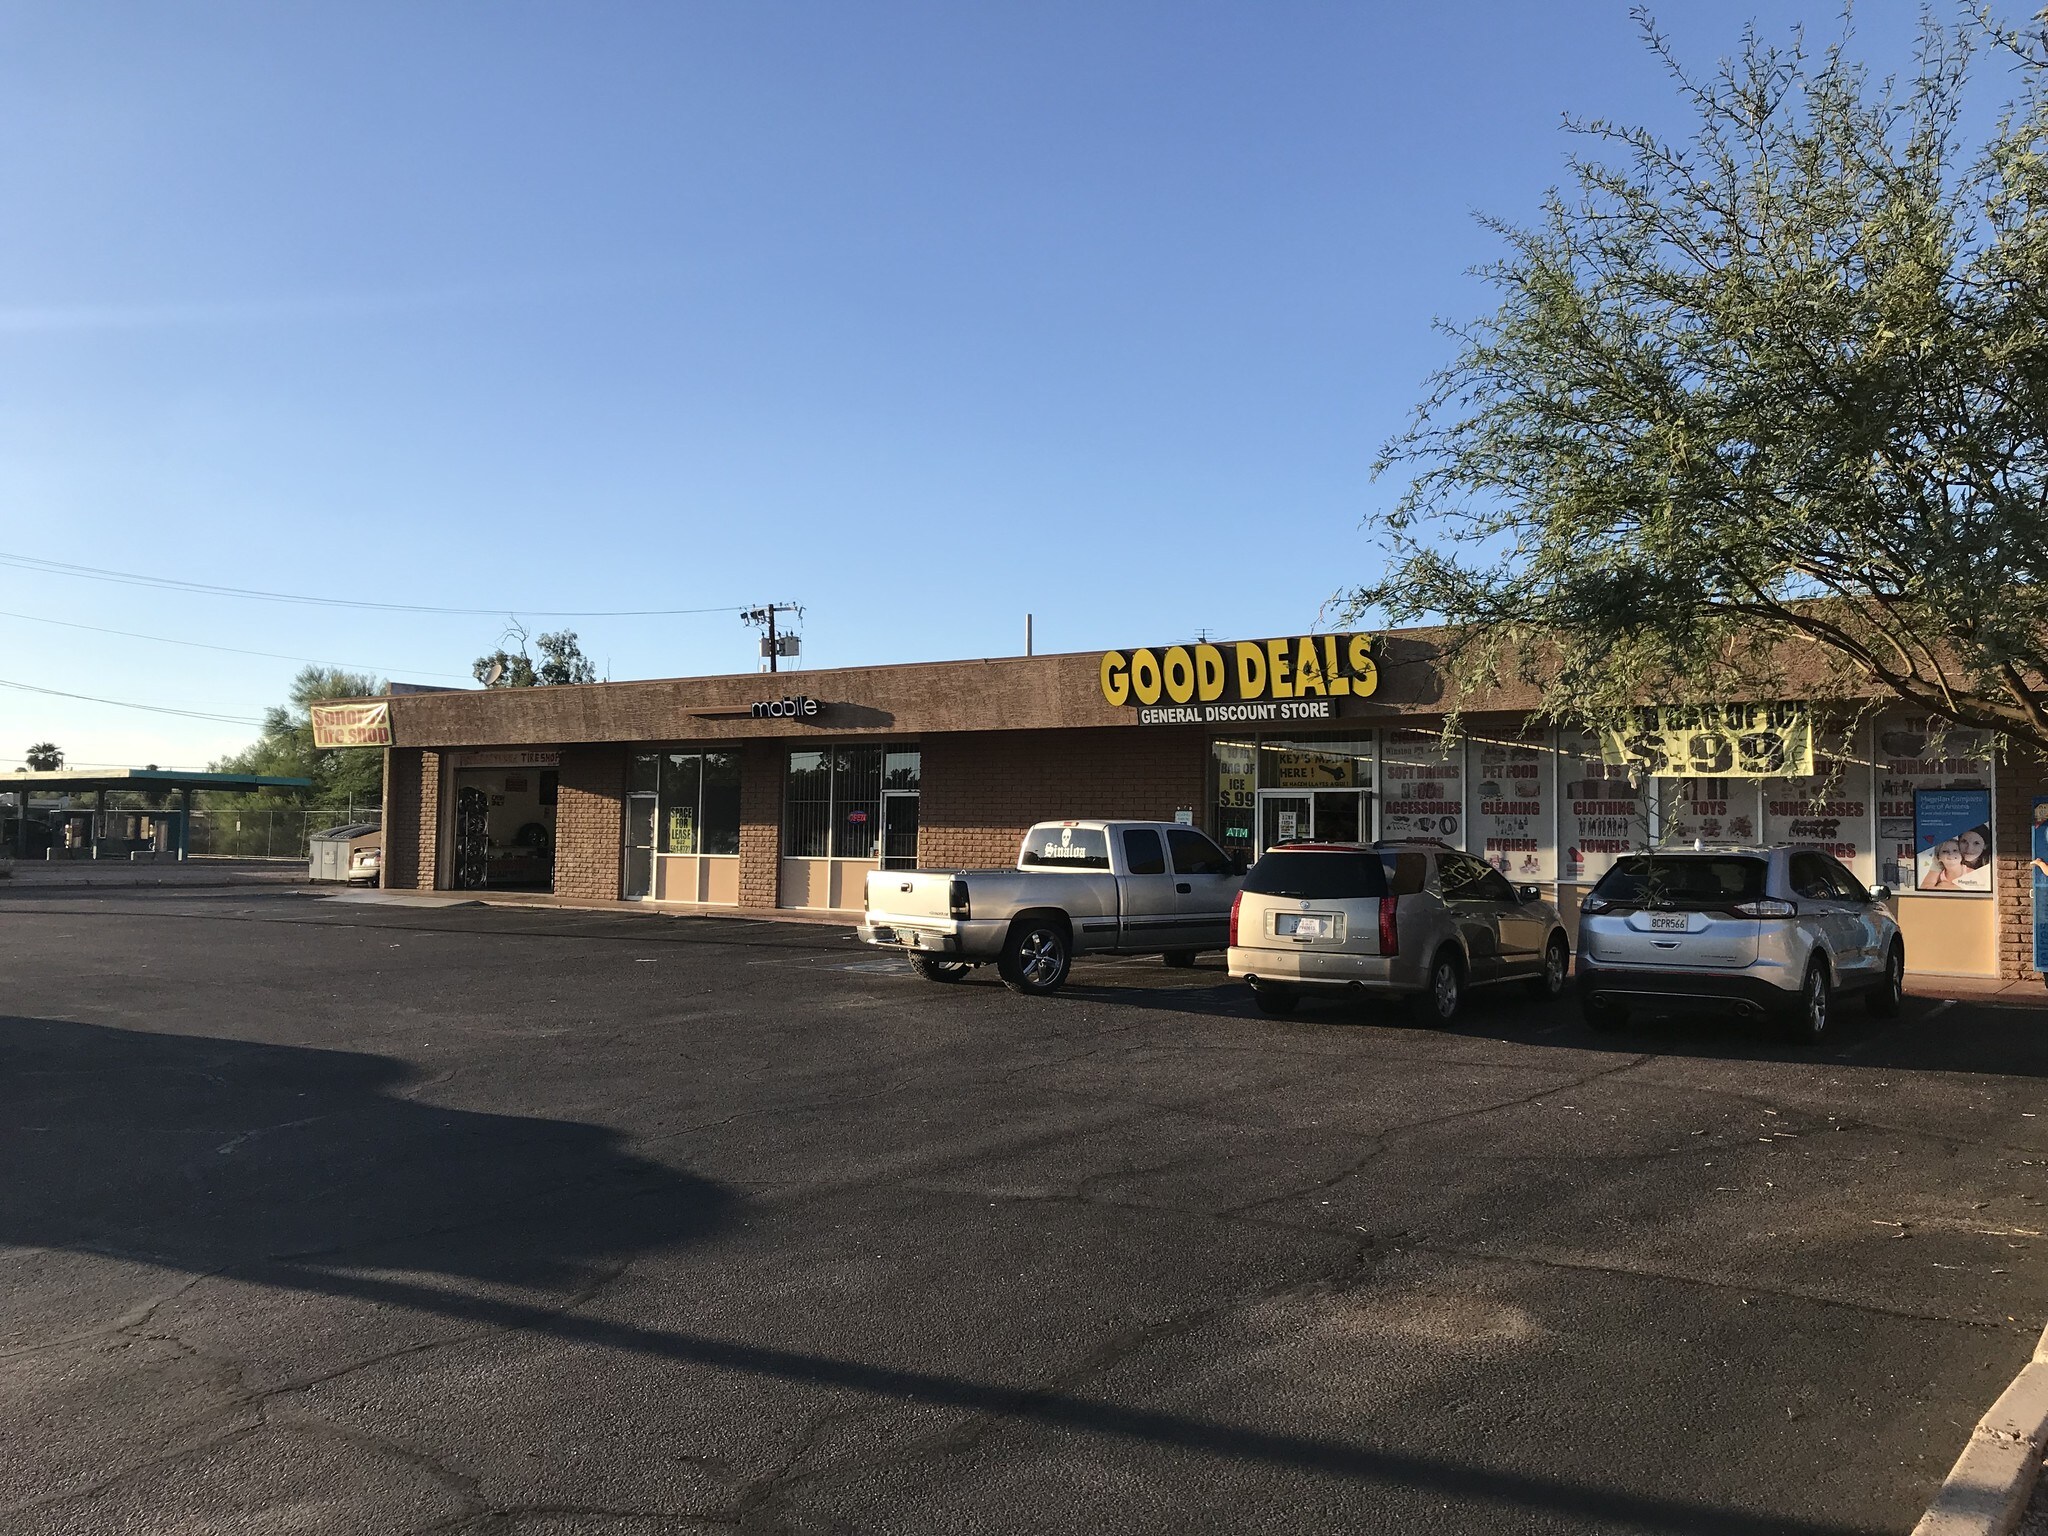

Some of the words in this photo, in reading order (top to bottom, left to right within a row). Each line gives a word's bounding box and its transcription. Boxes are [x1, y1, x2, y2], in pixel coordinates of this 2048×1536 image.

[1100, 643, 1225, 707] GOOD
[1236, 634, 1378, 700] DEALS
[751, 696, 818, 718] mobile
[1140, 711, 1203, 725] GENERAL
[1205, 705, 1277, 722] DISCOUNT
[1280, 703, 1330, 720] STORE
[315, 726, 345, 744] Tire
[348, 726, 389, 744] shop
[1279, 753, 1310, 764] KEY'S
[1221, 763, 1240, 775] BAG
[1243, 763, 1255, 775] OF
[1280, 767, 1308, 778] HERE
[1387, 766, 1415, 779] SOFT
[1417, 766, 1459, 779] DRINKS
[1483, 765, 1504, 779] PET
[1507, 765, 1538, 779] FOOD
[1887, 759, 1978, 775] FURNITURE
[1229, 779, 1245, 790] ICE
[1220, 790, 1255, 807] $.99
[671, 807, 692, 819] SPACE
[1385, 801, 1462, 815] ACCESSORIES
[1480, 801, 1540, 815] CLEANING
[1573, 801, 1635, 816] CLOTHING
[1691, 800, 1727, 816] TOYS
[1769, 801, 1864, 817] SUNGASSES
[675, 818, 689, 829] FOR
[671, 829, 691, 840] LEASE
[1225, 827, 1249, 839] ATM
[1044, 842, 1087, 858] Sinaloa
[1486, 837, 1538, 852] HYGIENE
[1579, 839, 1630, 853] TOWELS
[1651, 918, 1685, 929] 8CPR566
